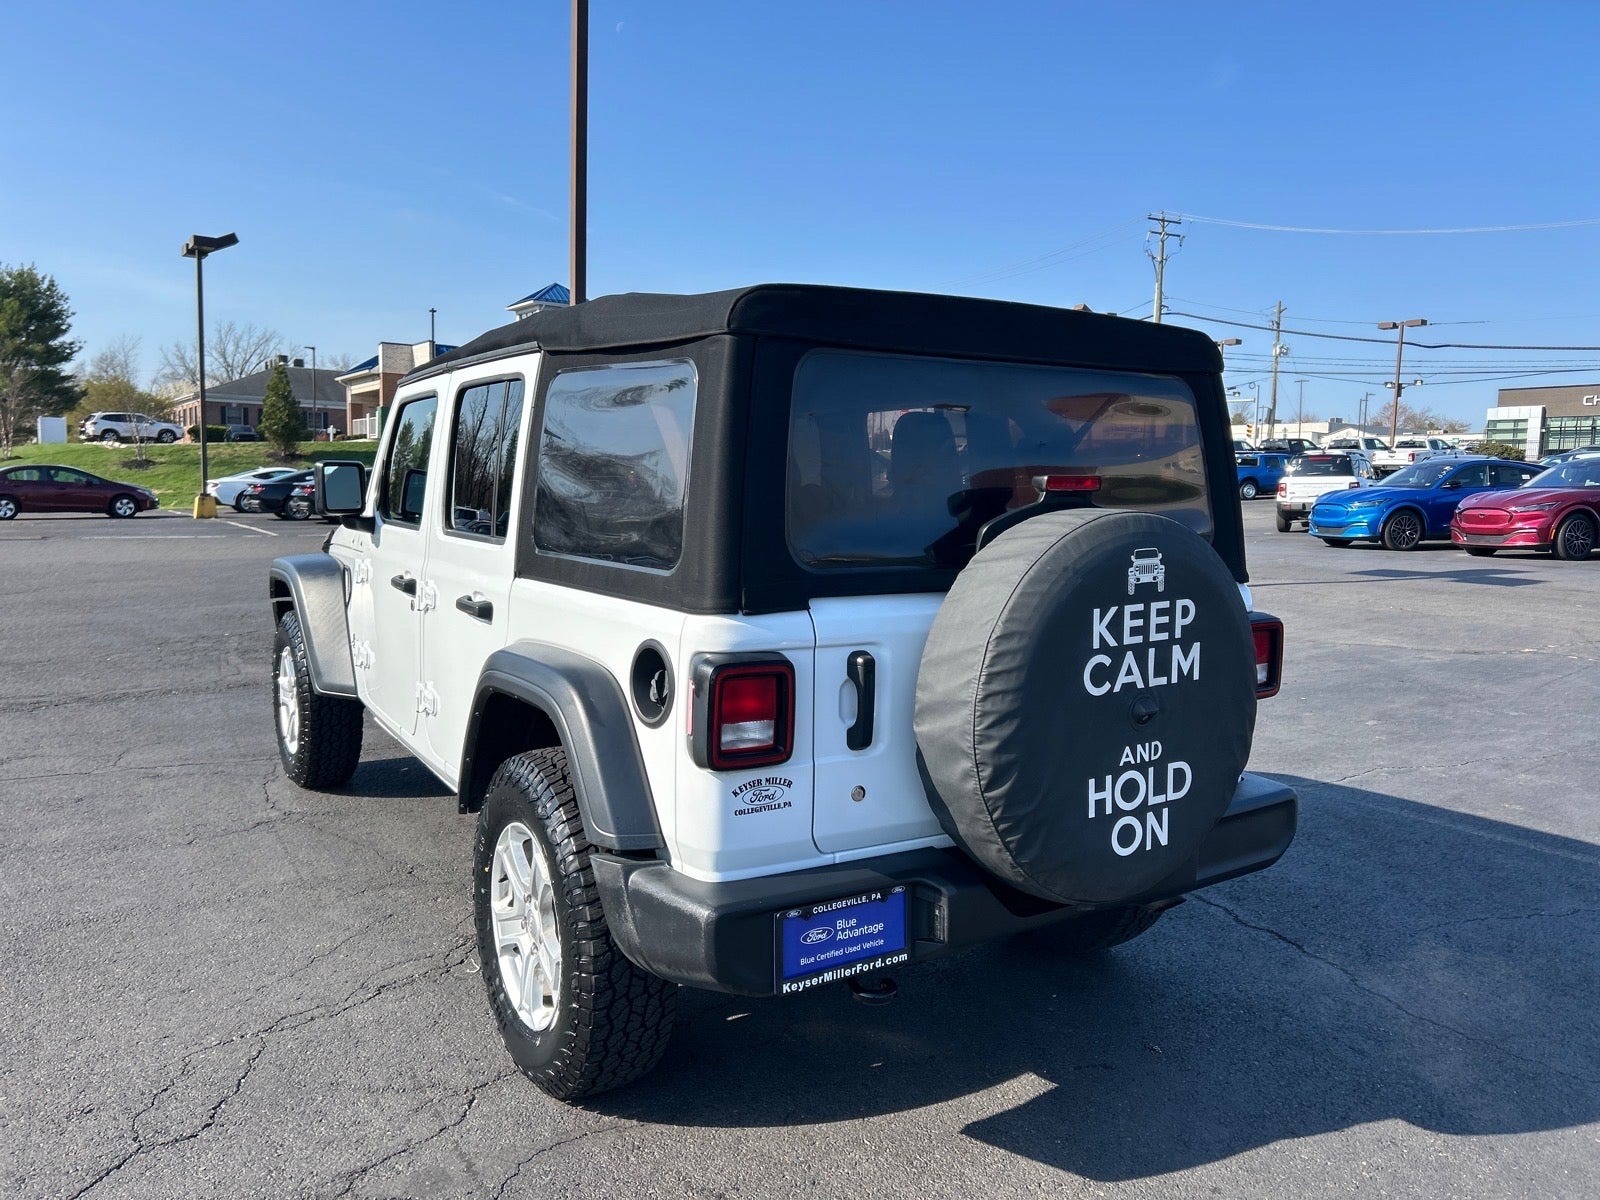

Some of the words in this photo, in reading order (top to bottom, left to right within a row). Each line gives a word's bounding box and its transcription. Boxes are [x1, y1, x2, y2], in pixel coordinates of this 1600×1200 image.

[1092, 598, 1196, 650] KEEP
[1083, 641, 1201, 697] CALM
[1119, 740, 1163, 767] AND
[731, 778, 763, 798] KEYSER
[764, 776, 793, 789] MILLER
[749, 788, 777, 803] Ford
[1088, 760, 1193, 819] HOLD
[1111, 807, 1169, 857] ON
[813, 897, 869, 914] COLLEGEVILLE,
[871, 892, 882, 900] PA
[806, 929, 828, 943] Ford
[836, 918, 857, 931] Blue
[836, 922, 884, 941] Advantage
[800, 956, 815, 966] Blue
[816, 948, 844, 961] Certified
[844, 943, 861, 954] Used
[862, 938, 884, 949] Vehicle
[783, 953, 908, 994] KeyserMillerFord.com
